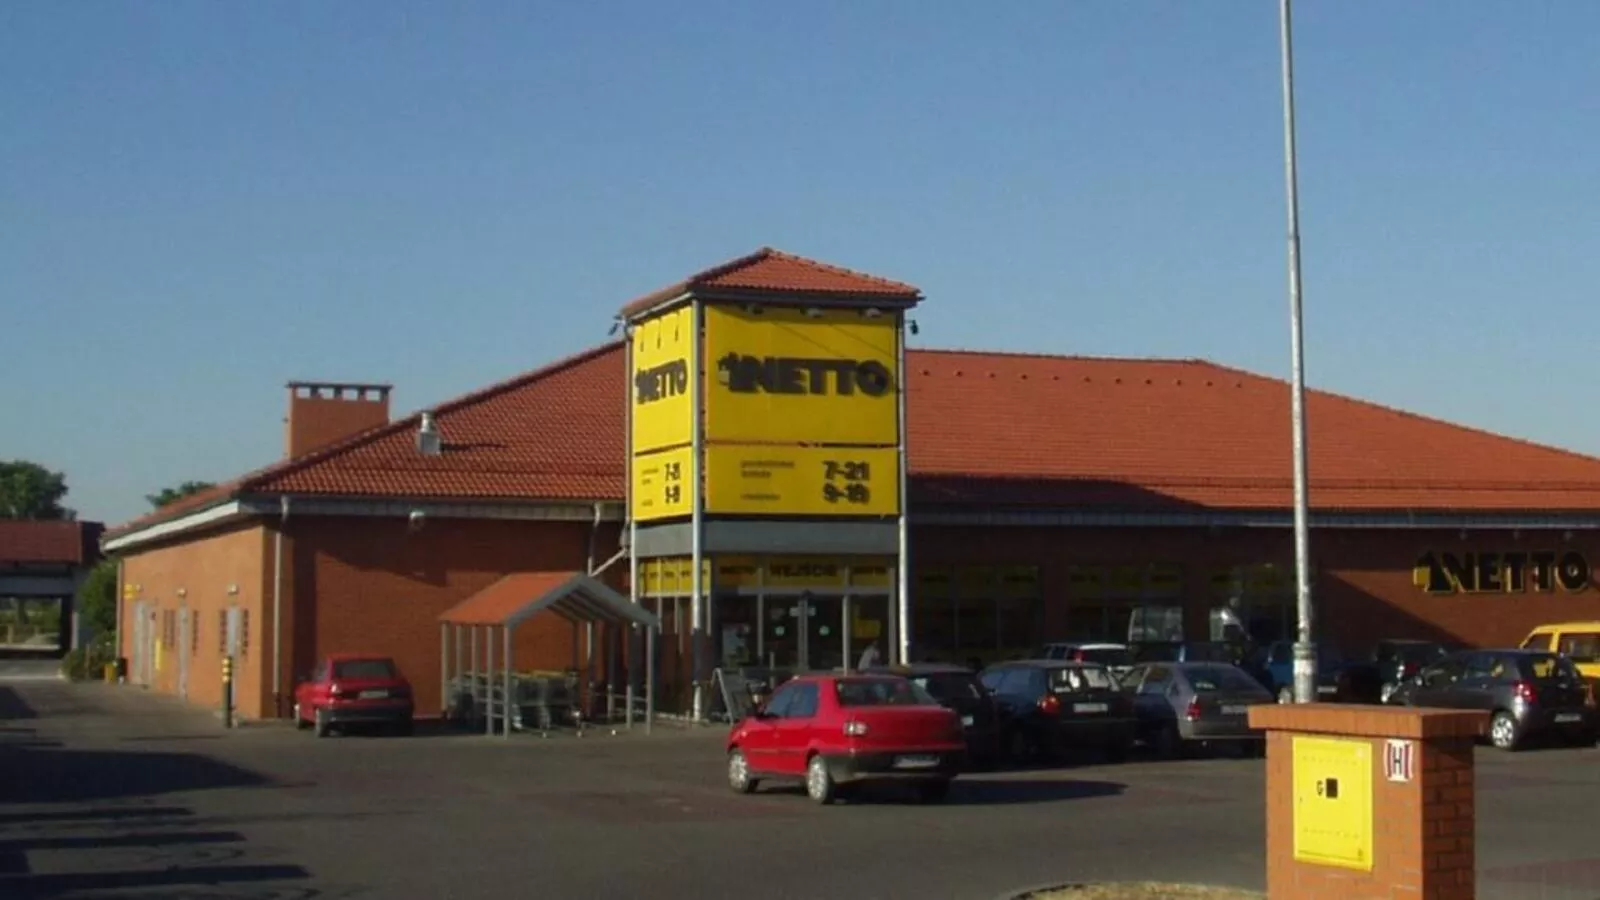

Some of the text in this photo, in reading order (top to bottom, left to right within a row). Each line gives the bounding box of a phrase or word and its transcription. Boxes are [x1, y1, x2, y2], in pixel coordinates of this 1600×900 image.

[640, 357, 688, 403] NETTO
[742, 355, 894, 397] NETTO
[821, 460, 870, 480] 7-21
[1441, 551, 1589, 593] NETTO
[1393, 747, 1403, 774] H
